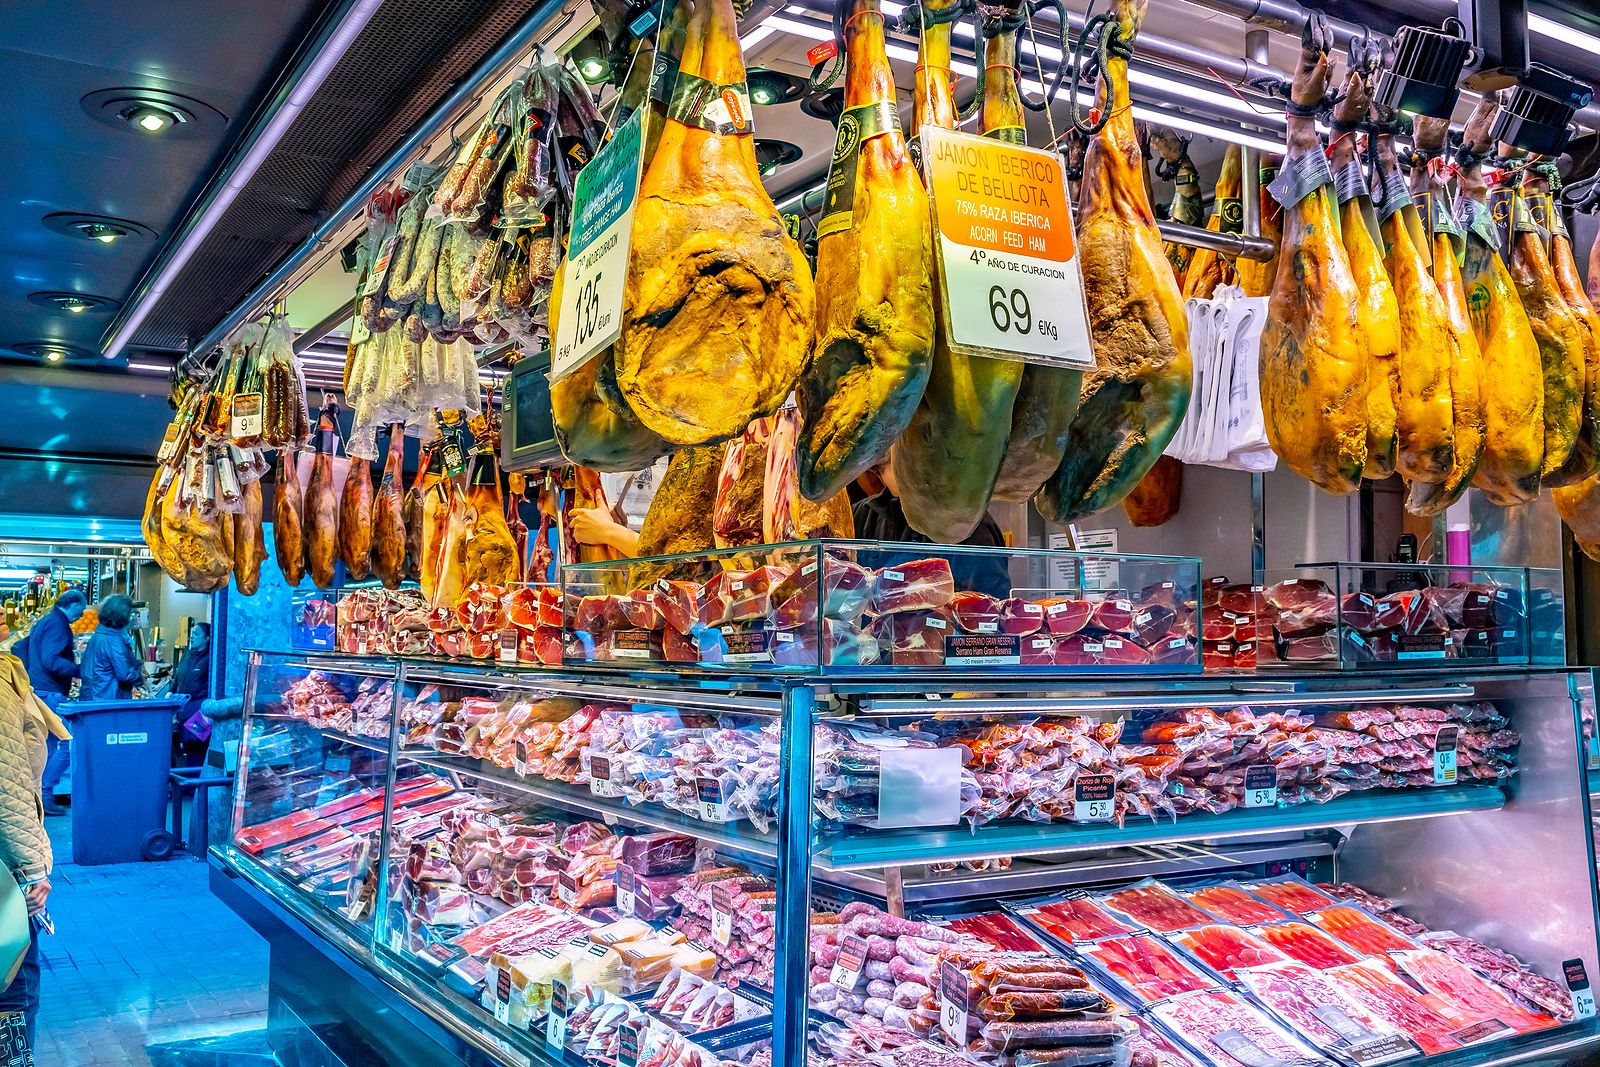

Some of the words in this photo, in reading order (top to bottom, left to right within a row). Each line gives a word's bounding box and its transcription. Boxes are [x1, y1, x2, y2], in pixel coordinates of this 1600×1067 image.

[937, 140, 988, 170] JAMON
[996, 155, 1053, 184] IBERICO
[957, 171, 978, 194] DE
[982, 176, 1050, 208] BELLOTA
[956, 200, 977, 216] 75%
[980, 204, 1008, 222] RAZA
[1010, 210, 1050, 230] IBERICA
[970, 225, 998, 243] ACORN
[1004, 230, 1024, 248] FEED
[1028, 236, 1046, 252] HAM
[988, 258, 1006, 270] AÑO
[1008, 262, 1020, 272] DE
[1022, 264, 1065, 280] CURACION
[574, 272, 602, 350] 135
[989, 285, 1032, 335] 69
[1038, 320, 1058, 340] €/Kg
[558, 349, 563, 361] 5
[241, 418, 248, 430] 9
[966, 638, 985, 646] SERRANO
[986, 638, 997, 646] GRAN
[998, 637, 1016, 646] RESERVA
[956, 647, 972, 656] Serrano
[973, 647, 983, 655] Ham
[984, 646, 994, 656] Gran
[994, 647, 1012, 655] Reserva
[1440, 752, 1446, 770] 9
[1255, 790, 1262, 804] 5
[707, 803, 712, 818] 6
[1090, 802, 1098, 816] 5
[836, 968, 848, 984] 26
[1577, 996, 1583, 1014] 6
[948, 1006, 954, 1027] 9
[553, 1018, 558, 1038] 6
